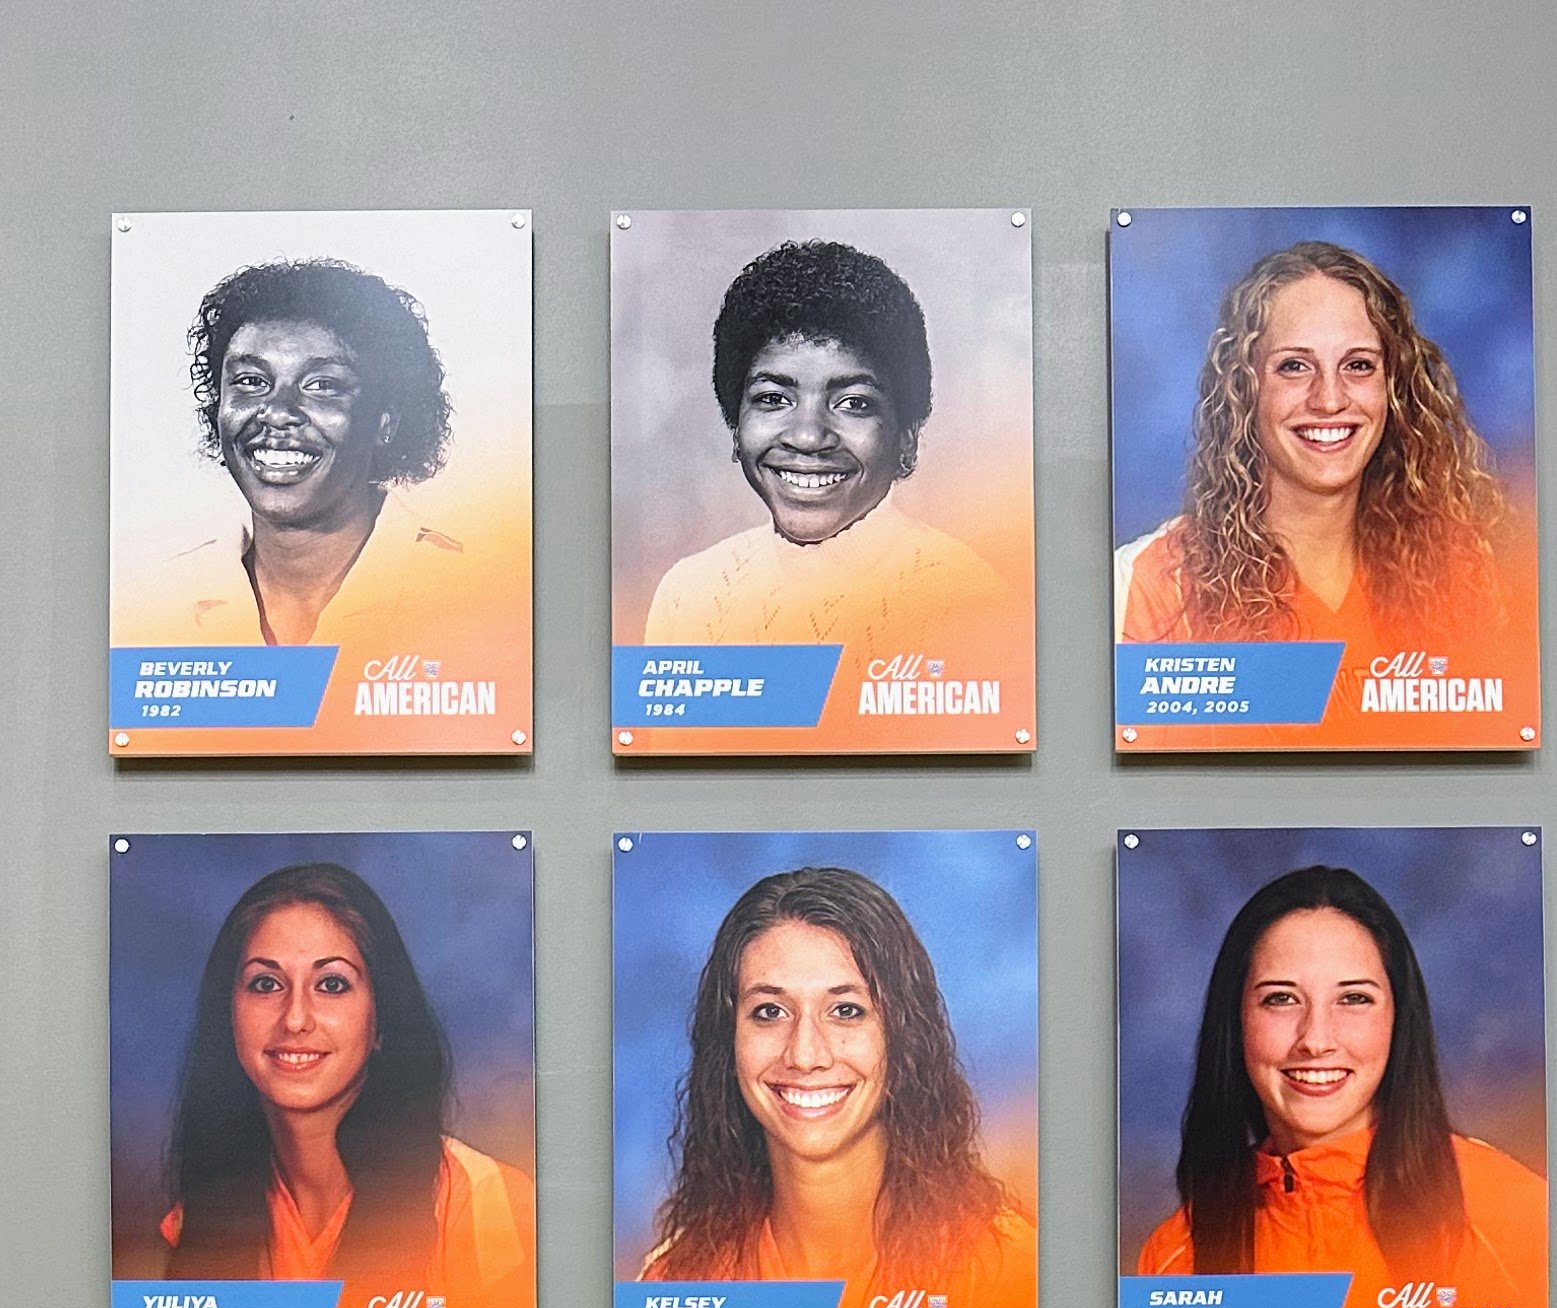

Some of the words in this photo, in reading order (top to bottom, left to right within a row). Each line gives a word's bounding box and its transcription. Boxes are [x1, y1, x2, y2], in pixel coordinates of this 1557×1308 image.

[140, 662, 232, 676] BEVERLY
[364, 655, 420, 681] All
[642, 660, 704, 675] APRIL
[867, 654, 924, 680] All
[1144, 658, 1236, 672] KRISTEN
[1370, 651, 1427, 678] All
[134, 680, 277, 698] ROBINSON
[638, 678, 765, 697] CHAPPLE
[1140, 676, 1236, 695] ANDRE
[354, 682, 496, 716] AMERICAN
[858, 681, 1000, 716] AMERICAN
[1361, 678, 1503, 713] AMERICAN
[141, 705, 181, 717] 1982
[645, 704, 686, 716] 1984
[1146, 701, 1198, 715] 2004,
[1204, 700, 1249, 713] 2005
[1149, 1291, 1223, 1305] SARAH
[1377, 1282, 1435, 1308] All
